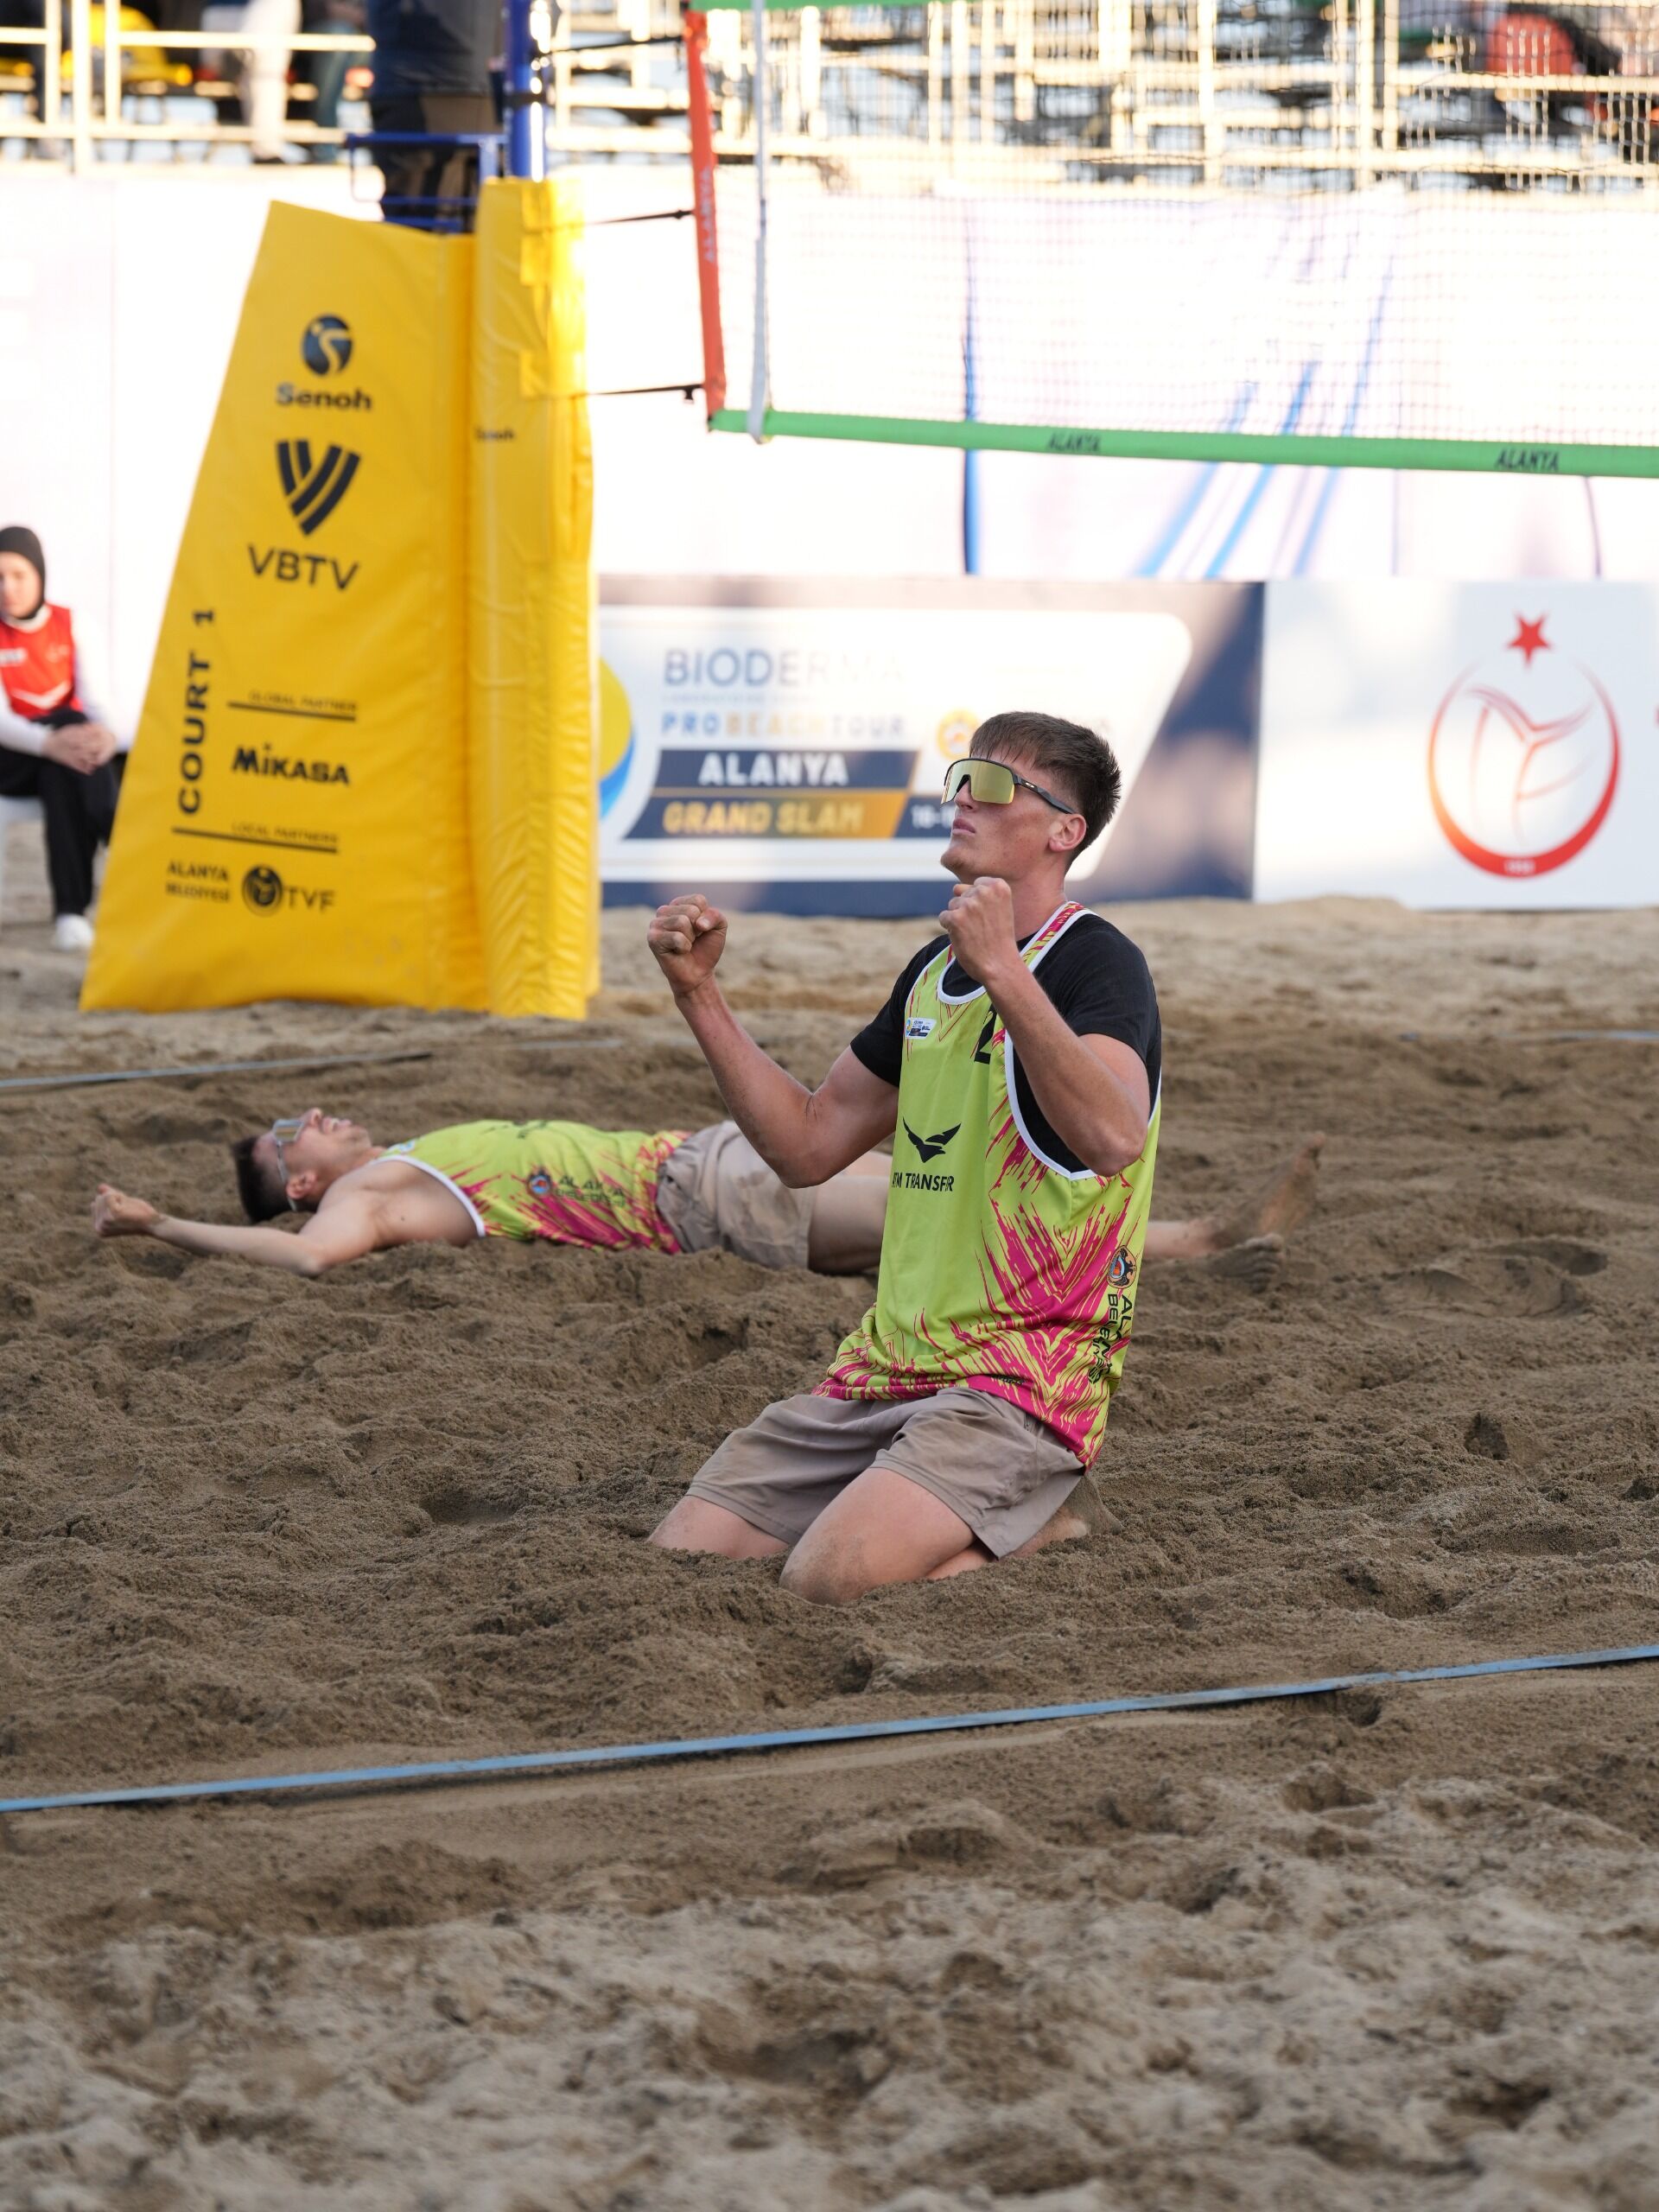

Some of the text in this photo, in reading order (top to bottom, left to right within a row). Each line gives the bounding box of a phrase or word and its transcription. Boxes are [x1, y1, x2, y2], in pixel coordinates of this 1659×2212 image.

[276, 383, 372, 410] Senoh
[1495, 449, 1559, 472] ALANYA
[248, 544, 359, 590] VBTV
[179, 608, 213, 814] COURT 1
[698, 753, 849, 786] ALANYA
[663, 802, 864, 834] GRAND SLAM
[167, 861, 230, 881] ALANYA
[284, 886, 336, 913] TVF
